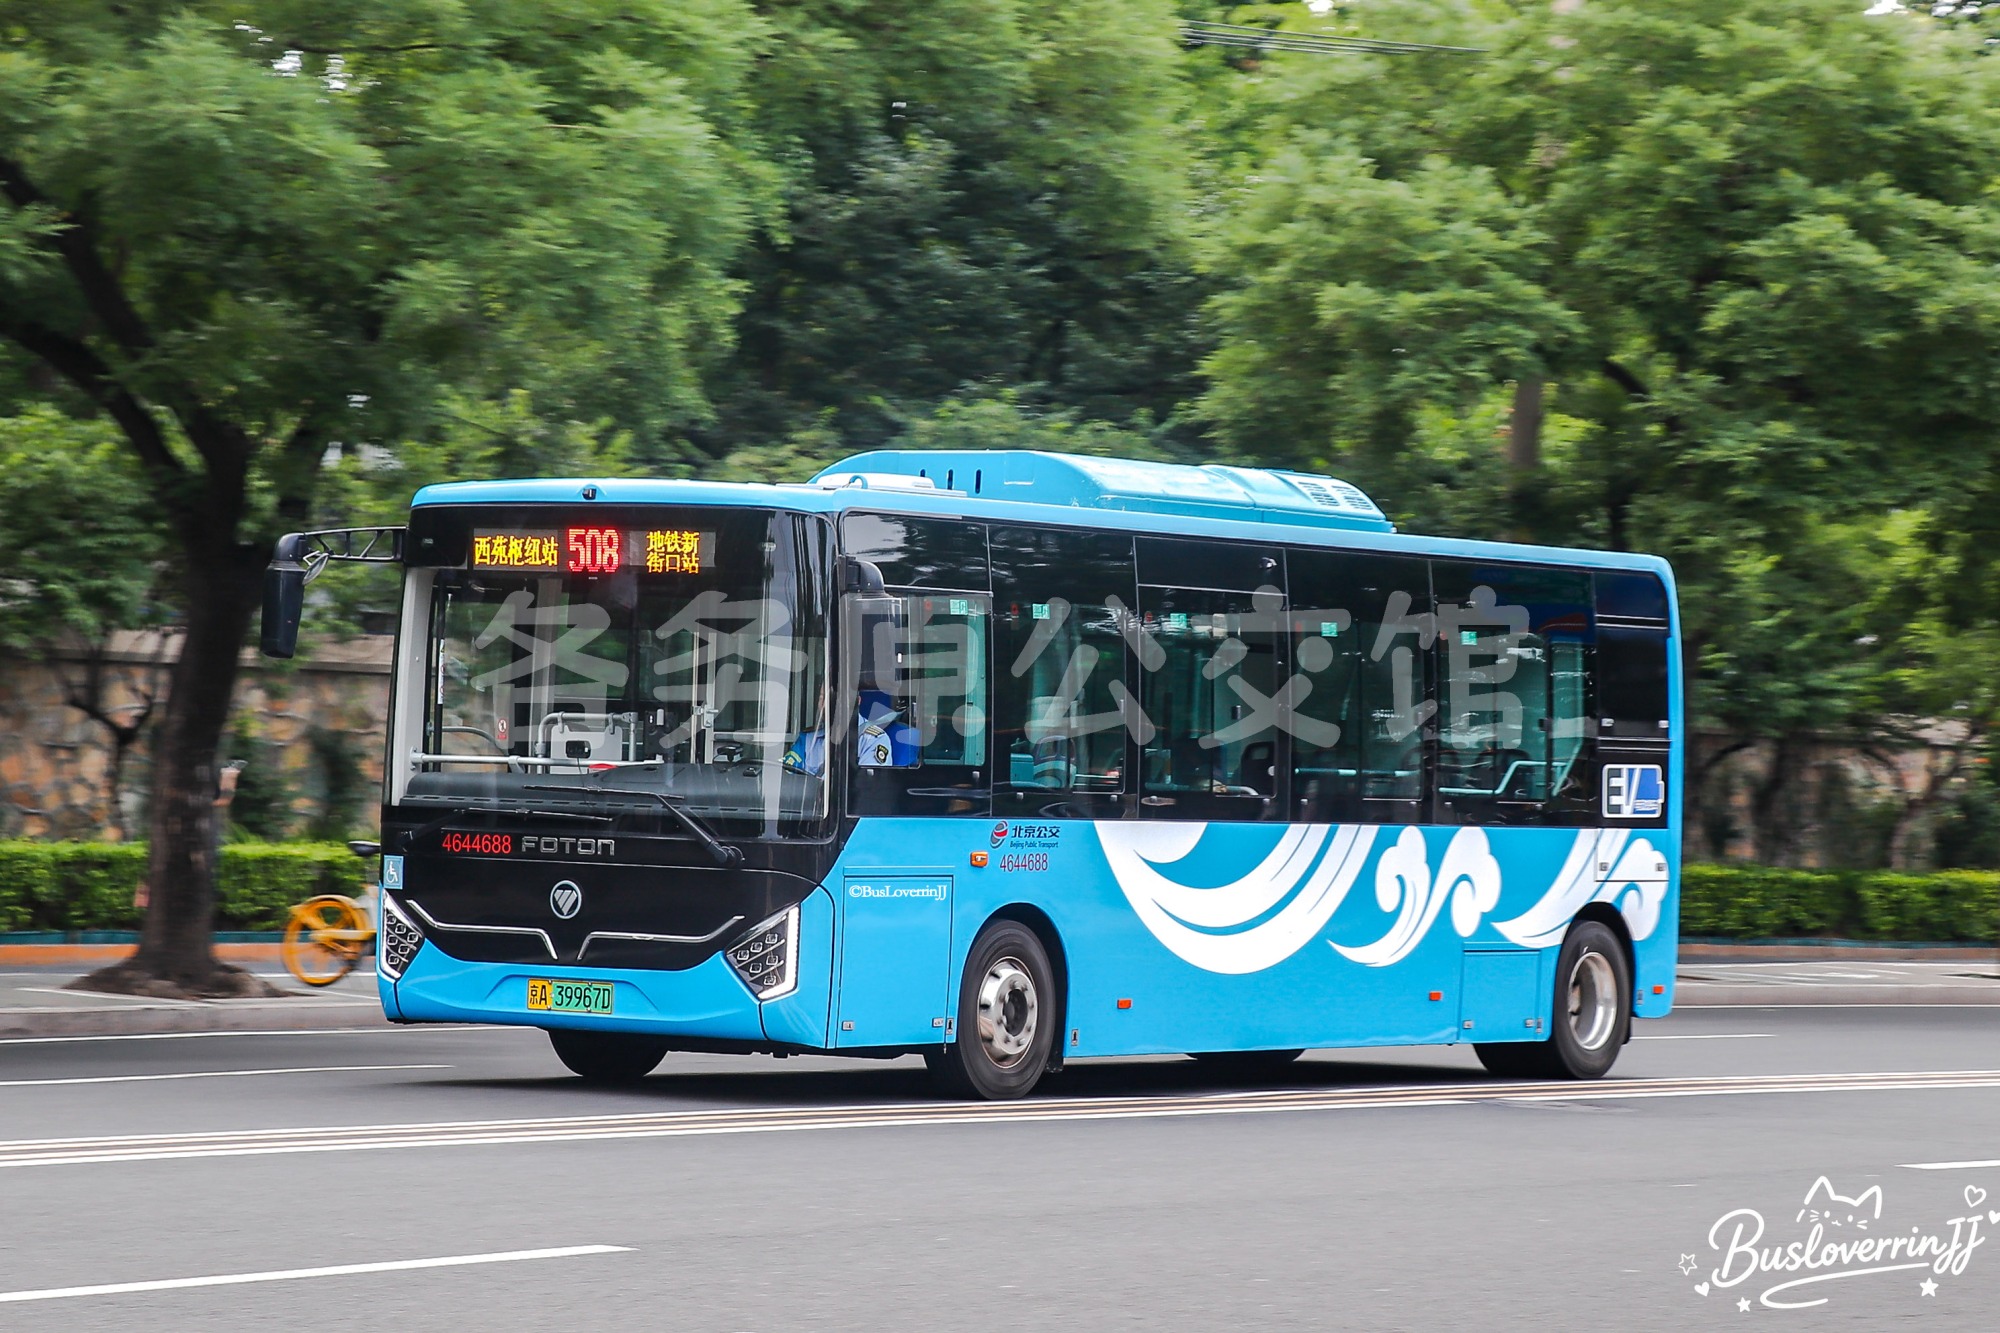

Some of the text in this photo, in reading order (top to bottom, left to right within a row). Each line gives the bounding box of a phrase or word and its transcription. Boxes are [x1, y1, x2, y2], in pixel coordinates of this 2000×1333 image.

[474, 536, 559, 566] 西苑枢纽站
[568, 528, 619, 573] 508
[646, 530, 699, 553] 地铁新
[646, 552, 699, 574] 街口站
[1011, 825, 1061, 839] 北京公交
[442, 833, 512, 854] 4644688
[521, 836, 615, 855] FOTON
[1010, 841, 1024, 849] Beijing
[1038, 841, 1059, 849] Transport
[1000, 853, 1048, 872] 4644688
